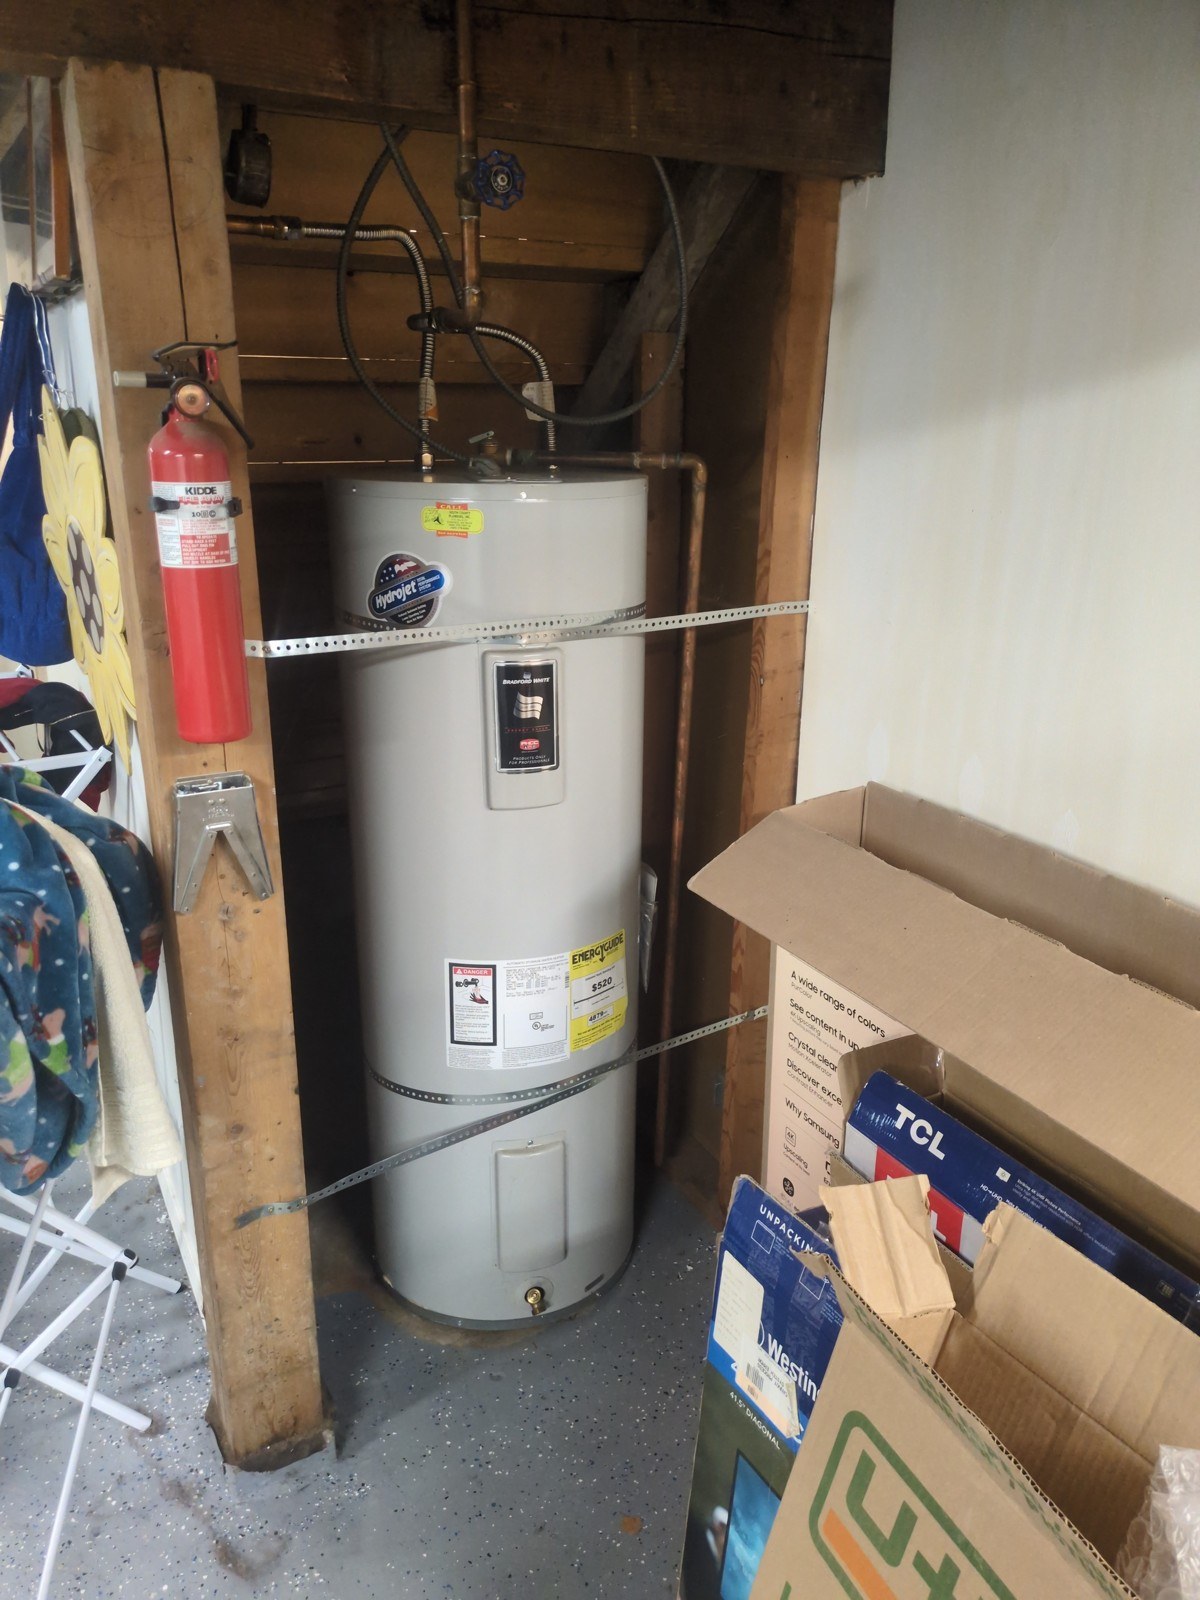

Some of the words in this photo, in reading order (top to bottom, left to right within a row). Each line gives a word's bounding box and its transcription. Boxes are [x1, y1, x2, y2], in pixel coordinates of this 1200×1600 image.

[185, 487, 217, 495] KIDDE
[375, 580, 417, 610] Hydrojet
[592, 976, 613, 992] $520
[791, 970, 797, 980] A
[798, 976, 818, 994] wide
[820, 990, 845, 1011] range
[846, 1008, 856, 1019] of
[857, 1015, 886, 1038] colors
[789, 999, 804, 1014] See
[805, 1011, 838, 1038] content
[839, 1031, 847, 1044] in
[796, 1013, 821, 1036] Upscaling
[788, 1032, 816, 1058] Crystal
[817, 1054, 838, 1073] clear
[787, 1058, 820, 1088] Discover
[822, 1086, 843, 1108] exce
[785, 1098, 802, 1118] Why
[803, 1113, 840, 1149] Samsung
[895, 1103, 945, 1160] TCL
[783, 1143, 809, 1170] Upscaling
[760, 1204, 819, 1254] UNPACKIN
[768, 1333, 820, 1402] Westin
[730, 1391, 746, 1408] 41.5"
[746, 1408, 780, 1450] DIAGONAL
